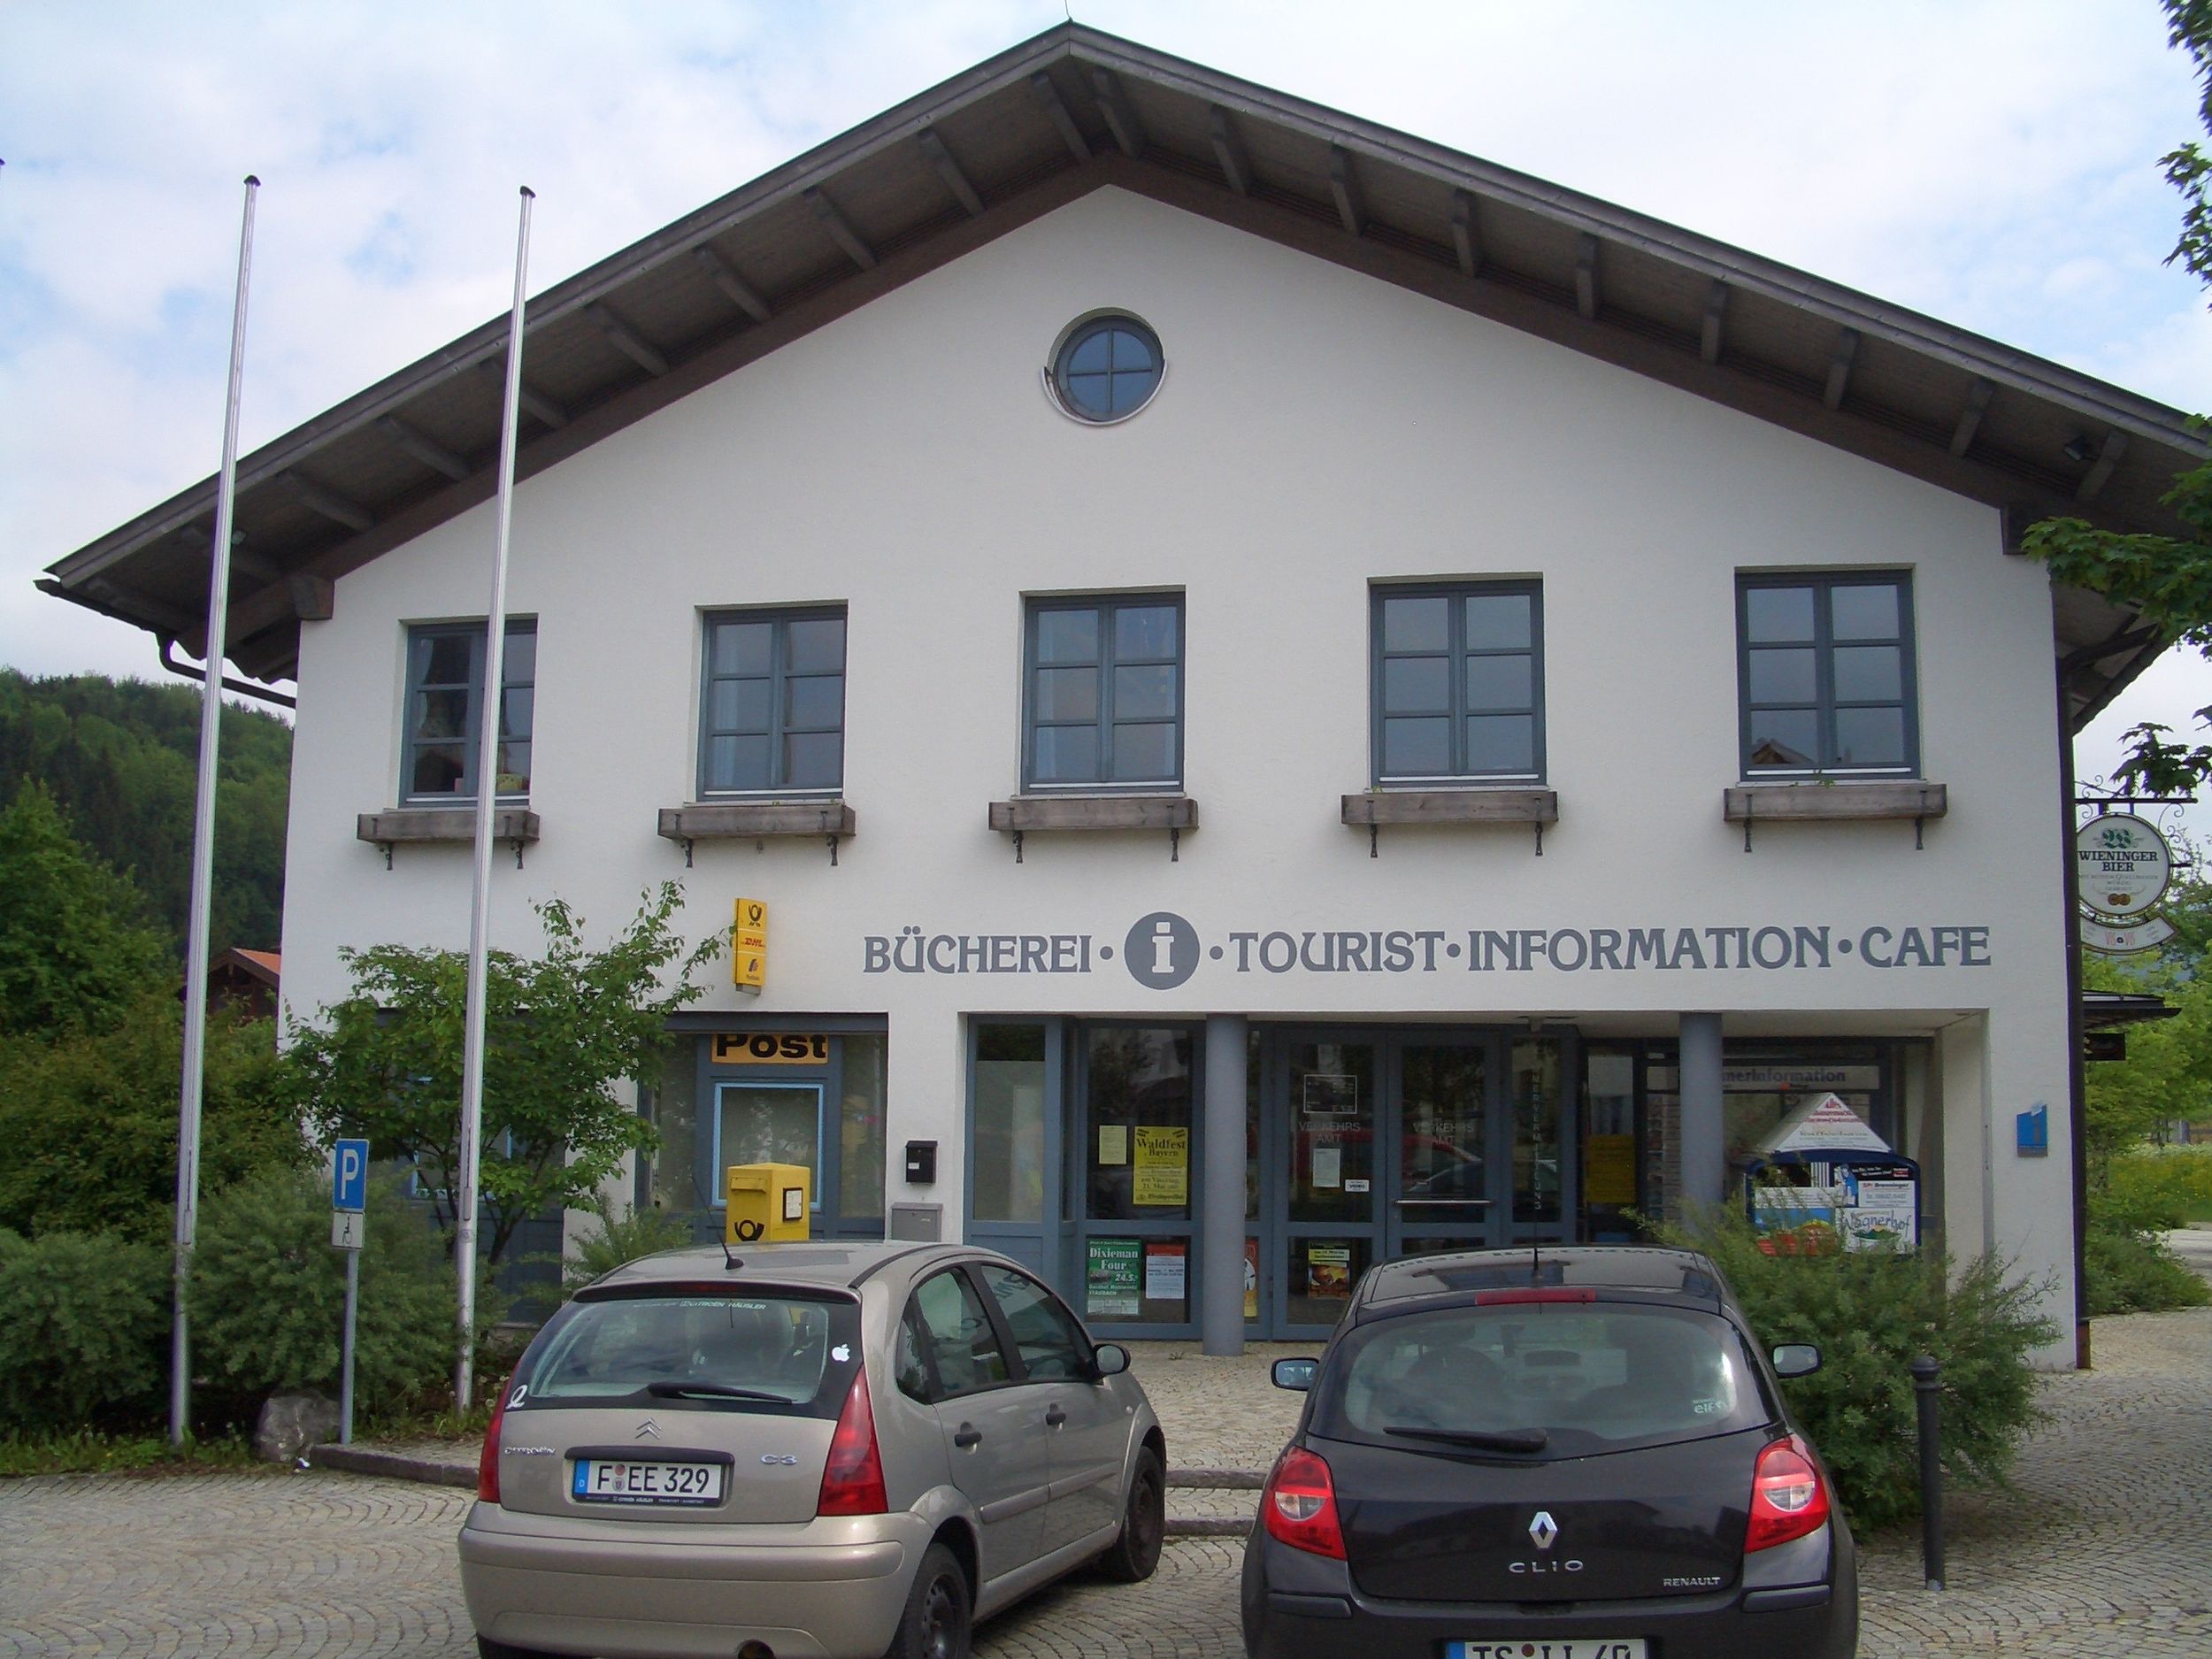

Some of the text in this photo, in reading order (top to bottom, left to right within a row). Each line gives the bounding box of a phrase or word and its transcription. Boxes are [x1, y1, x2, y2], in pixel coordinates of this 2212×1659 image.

[2079, 850, 2159, 862] WIENINGER
[2102, 862, 2135, 872] BIER
[744, 937, 763, 948] DHL
[863, 926, 1094, 974] BÜCHEREI
[1229, 930, 1446, 973] TOURIST
[1468, 926, 1832, 972] INFORMATION
[1859, 926, 1993, 969] CAFE
[716, 1033, 827, 1059] Post
[1136, 1138, 1187, 1149] Waldfest
[340, 1148, 359, 1200] P
[1089, 1248, 1139, 1258] Dixieman
[1101, 1259, 1127, 1271] Four
[760, 1453, 798, 1465] C3
[597, 1465, 710, 1494] F EE 329
[1508, 1558, 1585, 1575] CLIO
[1663, 1576, 1721, 1588] RENAULT
